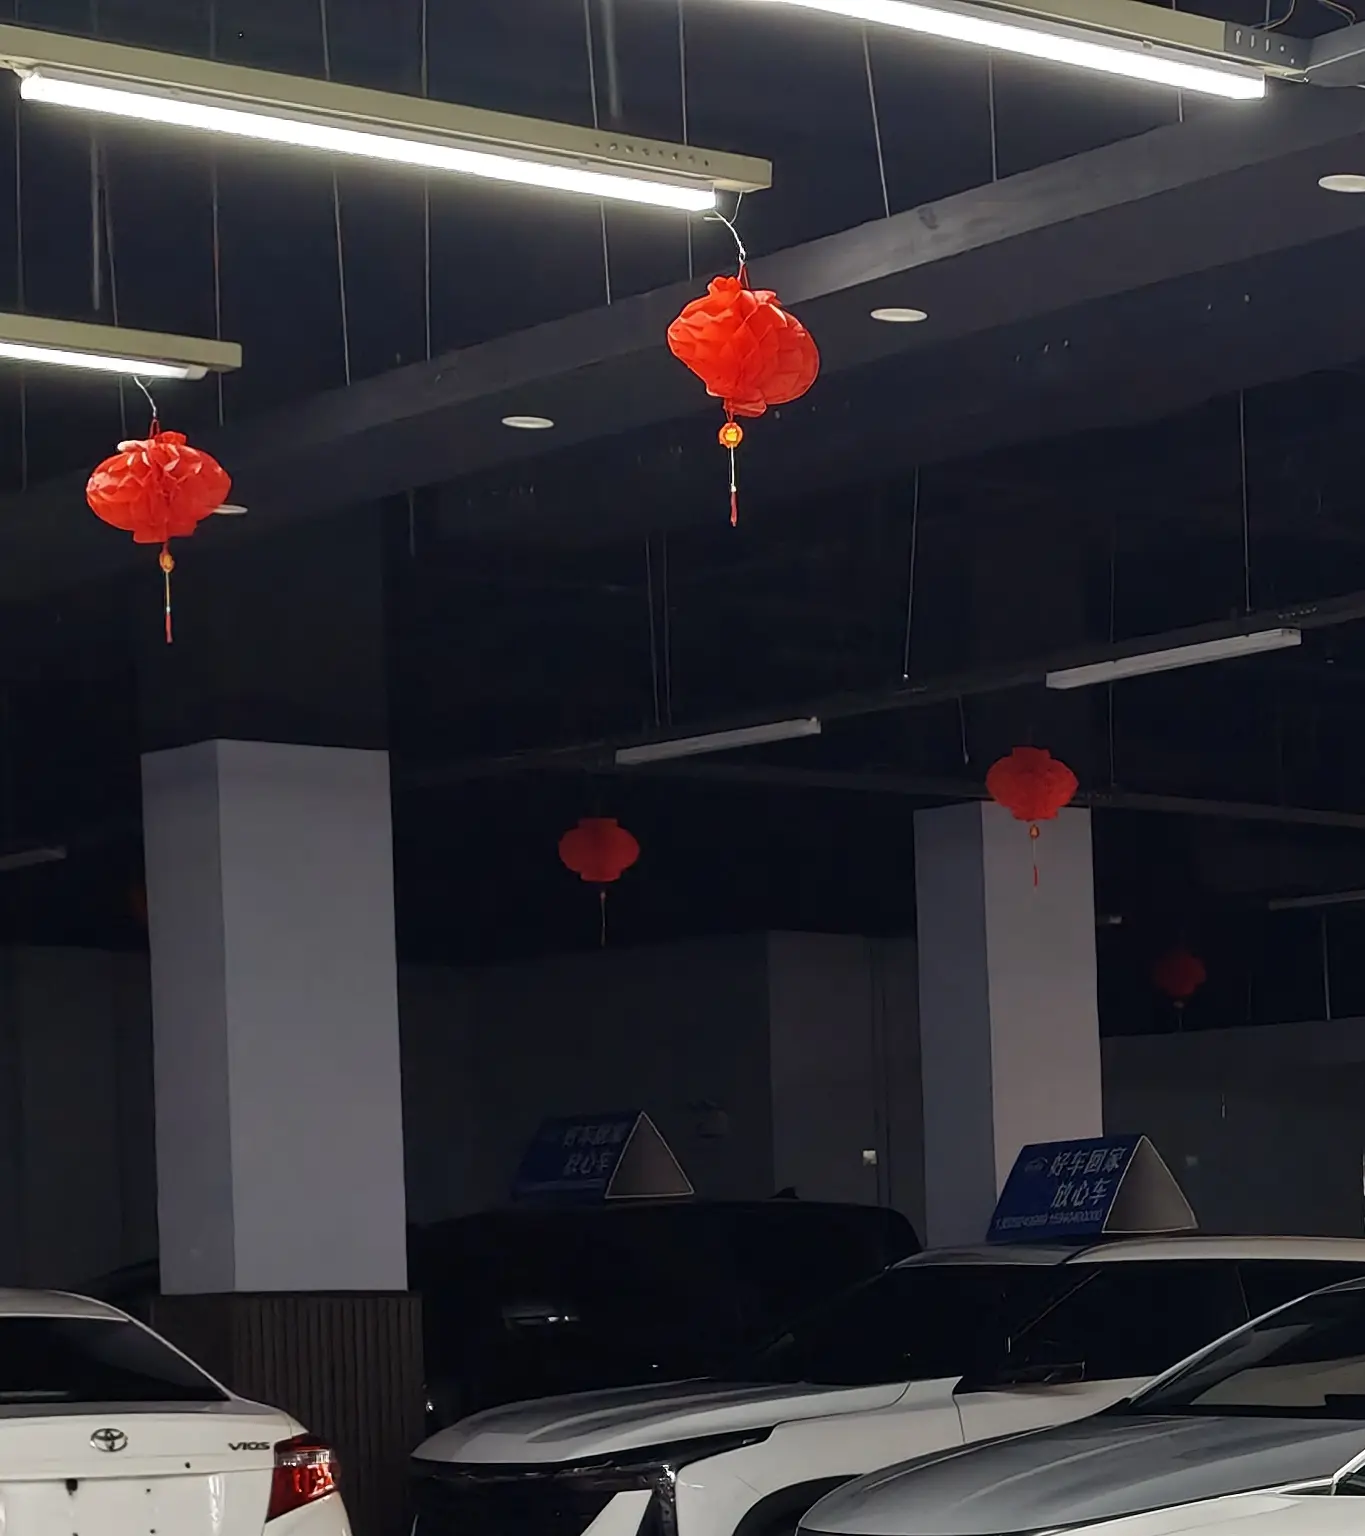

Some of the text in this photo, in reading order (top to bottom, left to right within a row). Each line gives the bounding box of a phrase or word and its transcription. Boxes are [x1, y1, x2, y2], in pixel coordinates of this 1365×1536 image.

[1050, 1178, 1112, 1208] 放心车
[228, 1441, 270, 1451] VIOS
